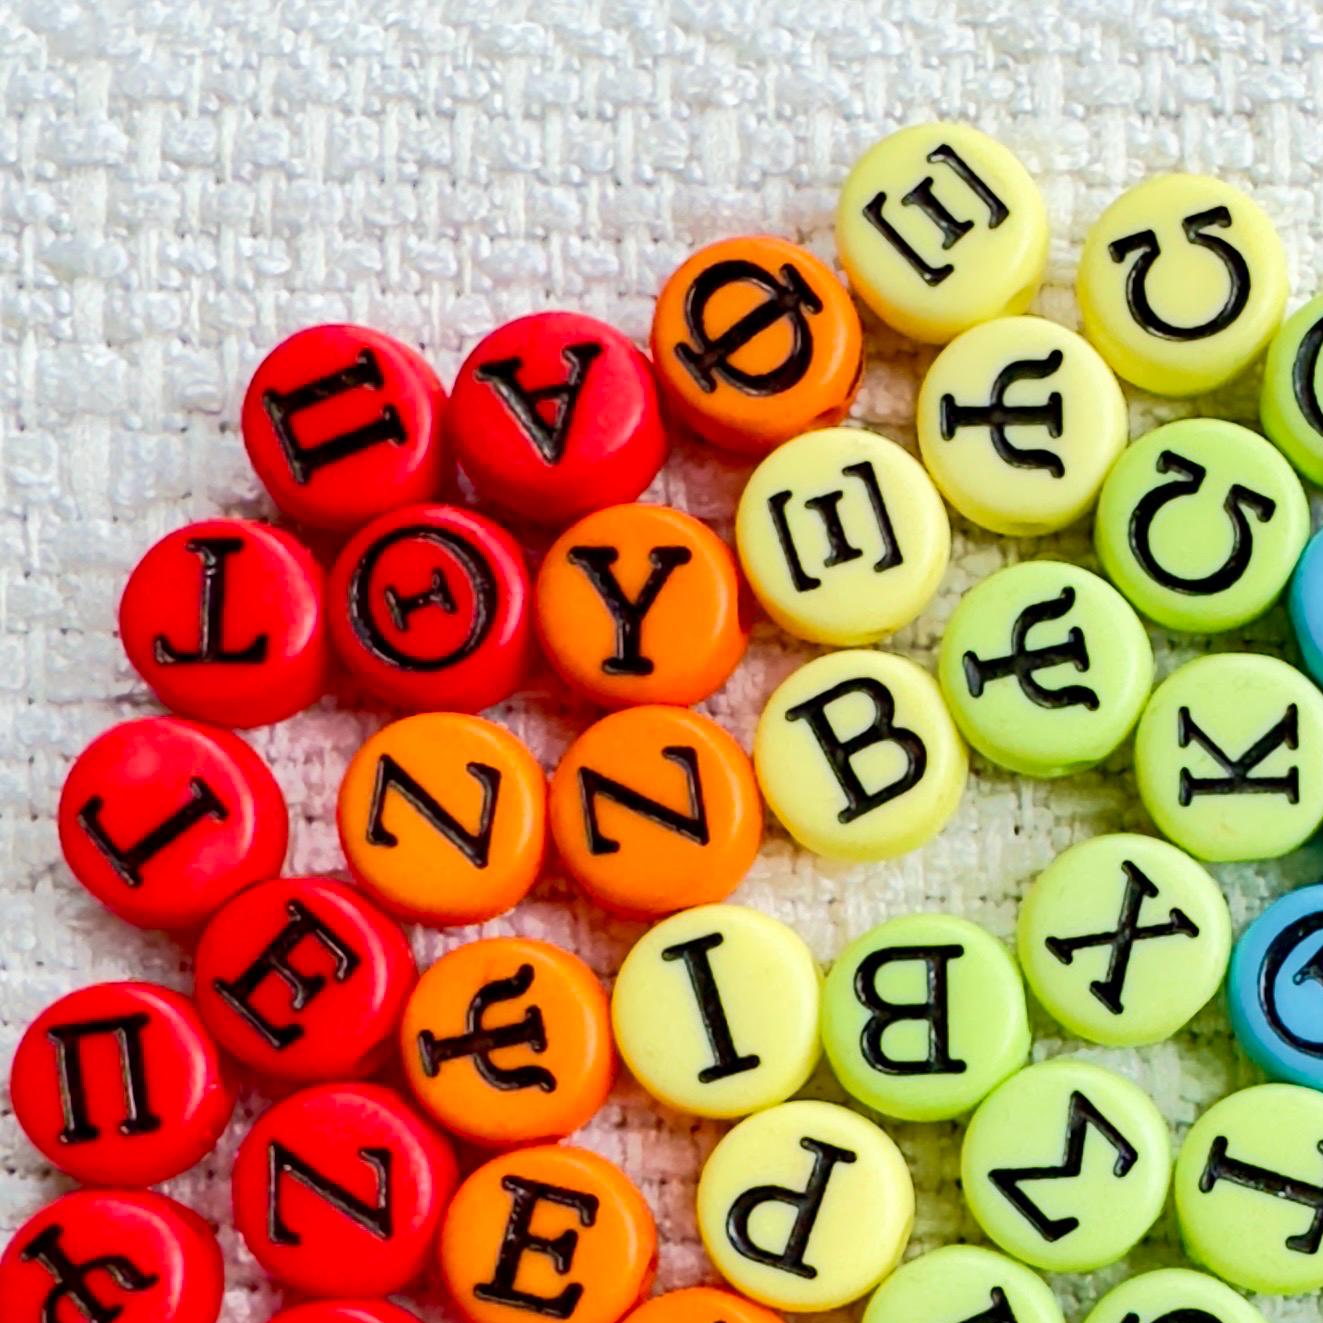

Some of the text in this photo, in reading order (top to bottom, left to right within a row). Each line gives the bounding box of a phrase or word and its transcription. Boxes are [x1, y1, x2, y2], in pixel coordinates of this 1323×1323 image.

[862, 143, 1010, 287] Ξ
[1108, 205, 1252, 342] Ω
[674, 260, 823, 395] Φ
[263, 349, 407, 485] Π
[939, 349, 1066, 479] Ψ
[767, 460, 904, 593] Ξ
[1127, 449, 1277, 597] Ω
[348, 524, 498, 673] Θ
[962, 586, 1100, 712] Ψ
[79, 778, 228, 888] Γ
[47, 1013, 161, 1145] Π
[419, 964, 556, 1093] Ψ
[987, 1090, 1139, 1243] Σ
